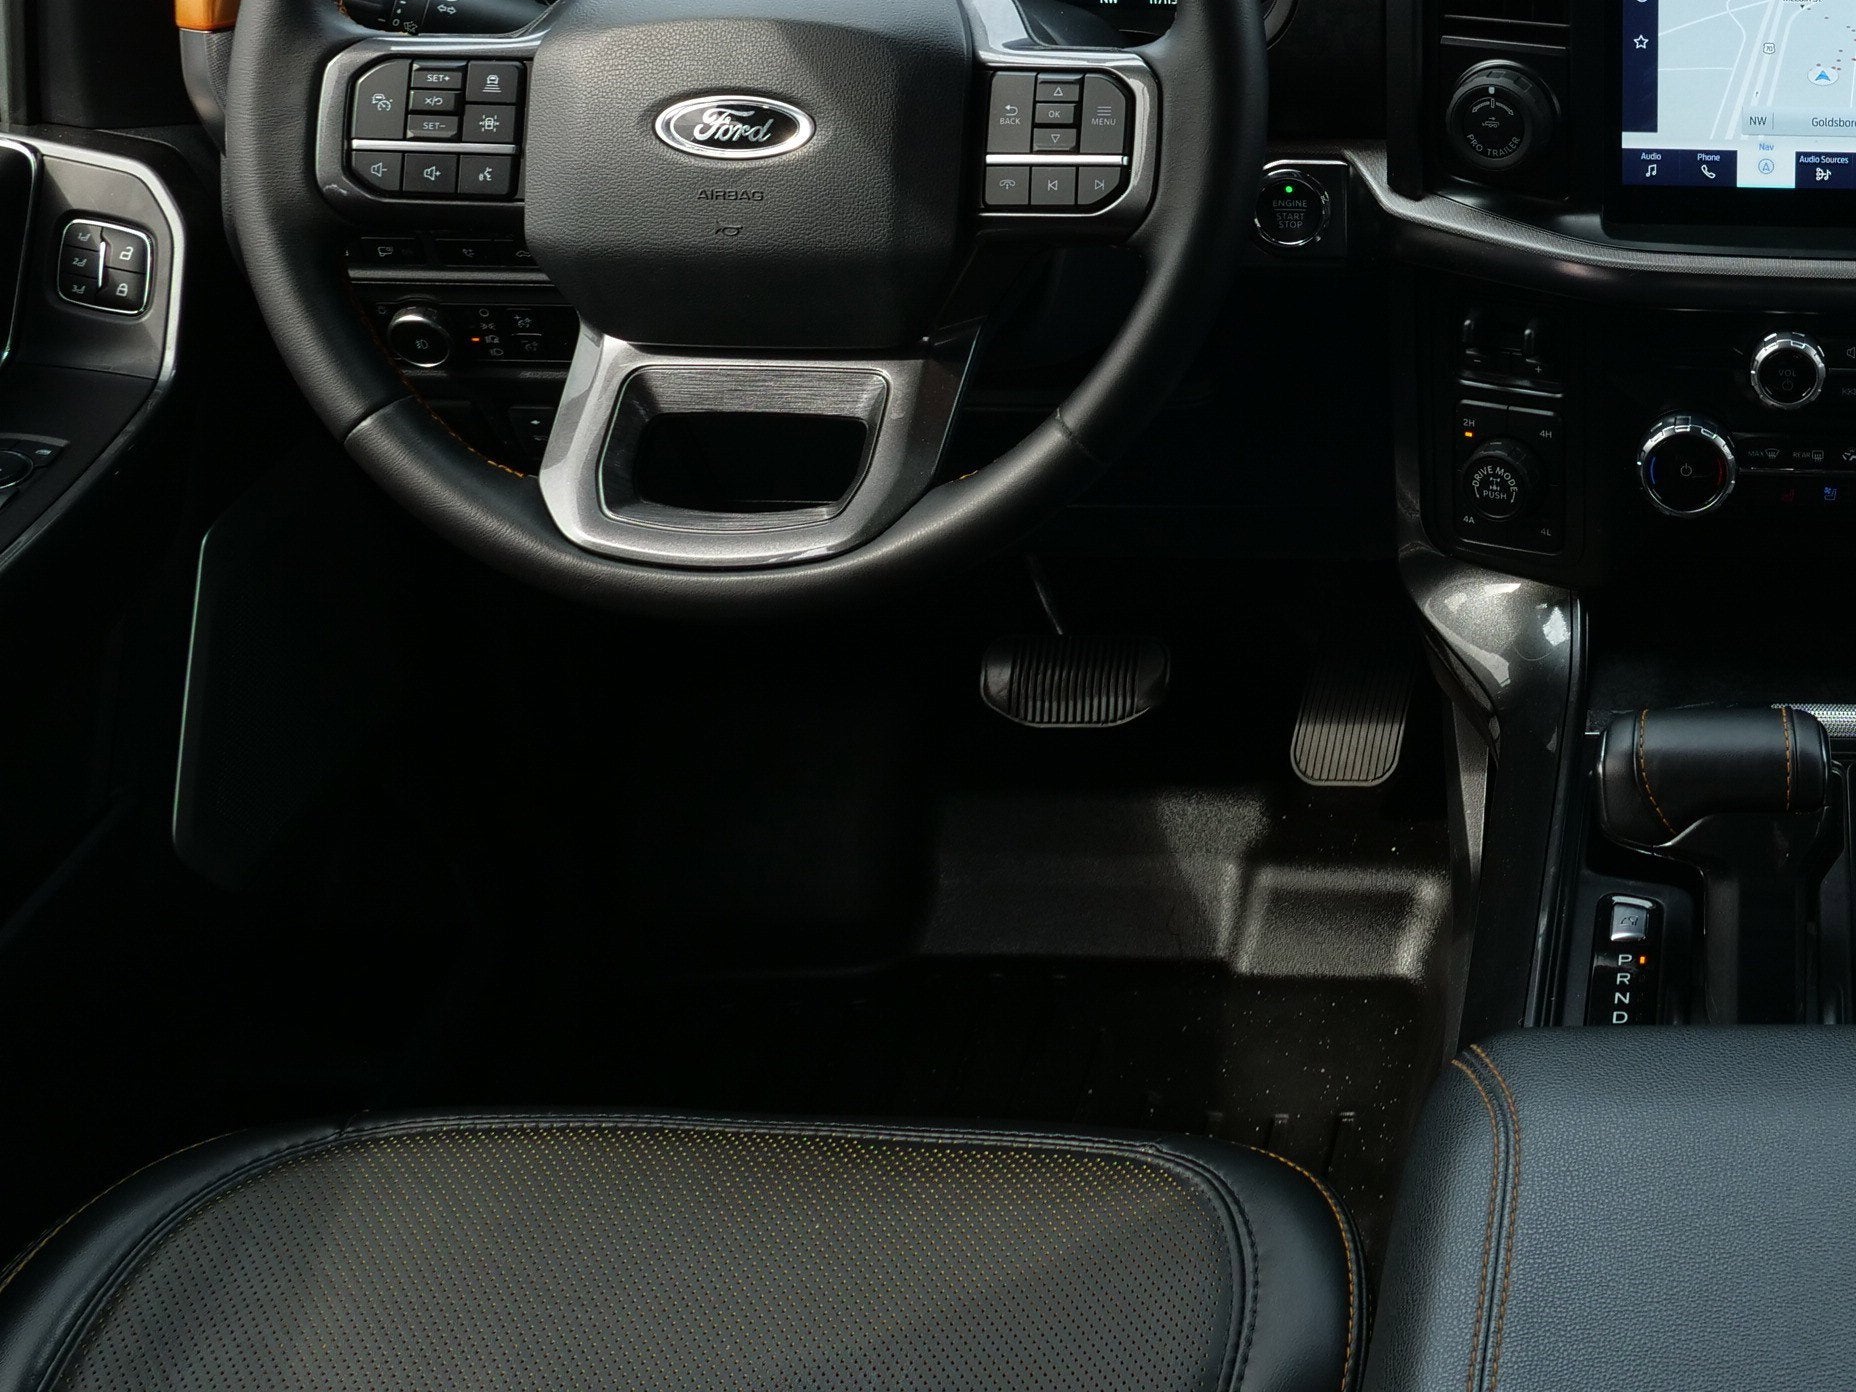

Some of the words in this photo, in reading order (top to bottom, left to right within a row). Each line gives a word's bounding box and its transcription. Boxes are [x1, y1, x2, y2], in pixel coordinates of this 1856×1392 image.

[1048, 110, 1060, 118] OK
[692, 108, 772, 142] Ford
[999, 117, 1021, 125] BACK
[1091, 118, 1116, 126] MENU
[1749, 116, 1767, 127] NW
[1467, 134, 1483, 152] PRO
[1487, 137, 1520, 157] TRAILER
[1758, 142, 1774, 151] Nav
[1641, 152, 1661, 161] Audio
[1697, 153, 1720, 162] Phone
[1799, 155, 1819, 164] Audio
[1821, 156, 1849, 165] Sources
[697, 188, 764, 202] AIRBAG
[1272, 199, 1308, 208] ENGINE
[1276, 212, 1305, 221] START
[1278, 220, 1304, 229] STOP
[1778, 369, 1797, 378] VOL
[1463, 418, 1475, 427] 2H
[1539, 430, 1552, 439] 4H
[1472, 465, 1494, 488] DRIVE
[1496, 466, 1519, 492] MODE
[1483, 490, 1507, 500] PUSH
[1463, 515, 1475, 524] 4A
[1618, 953, 1633, 966] P
[1617, 972, 1631, 985] R
[1614, 992, 1630, 1004] N
[1612, 1011, 1629, 1024] D
